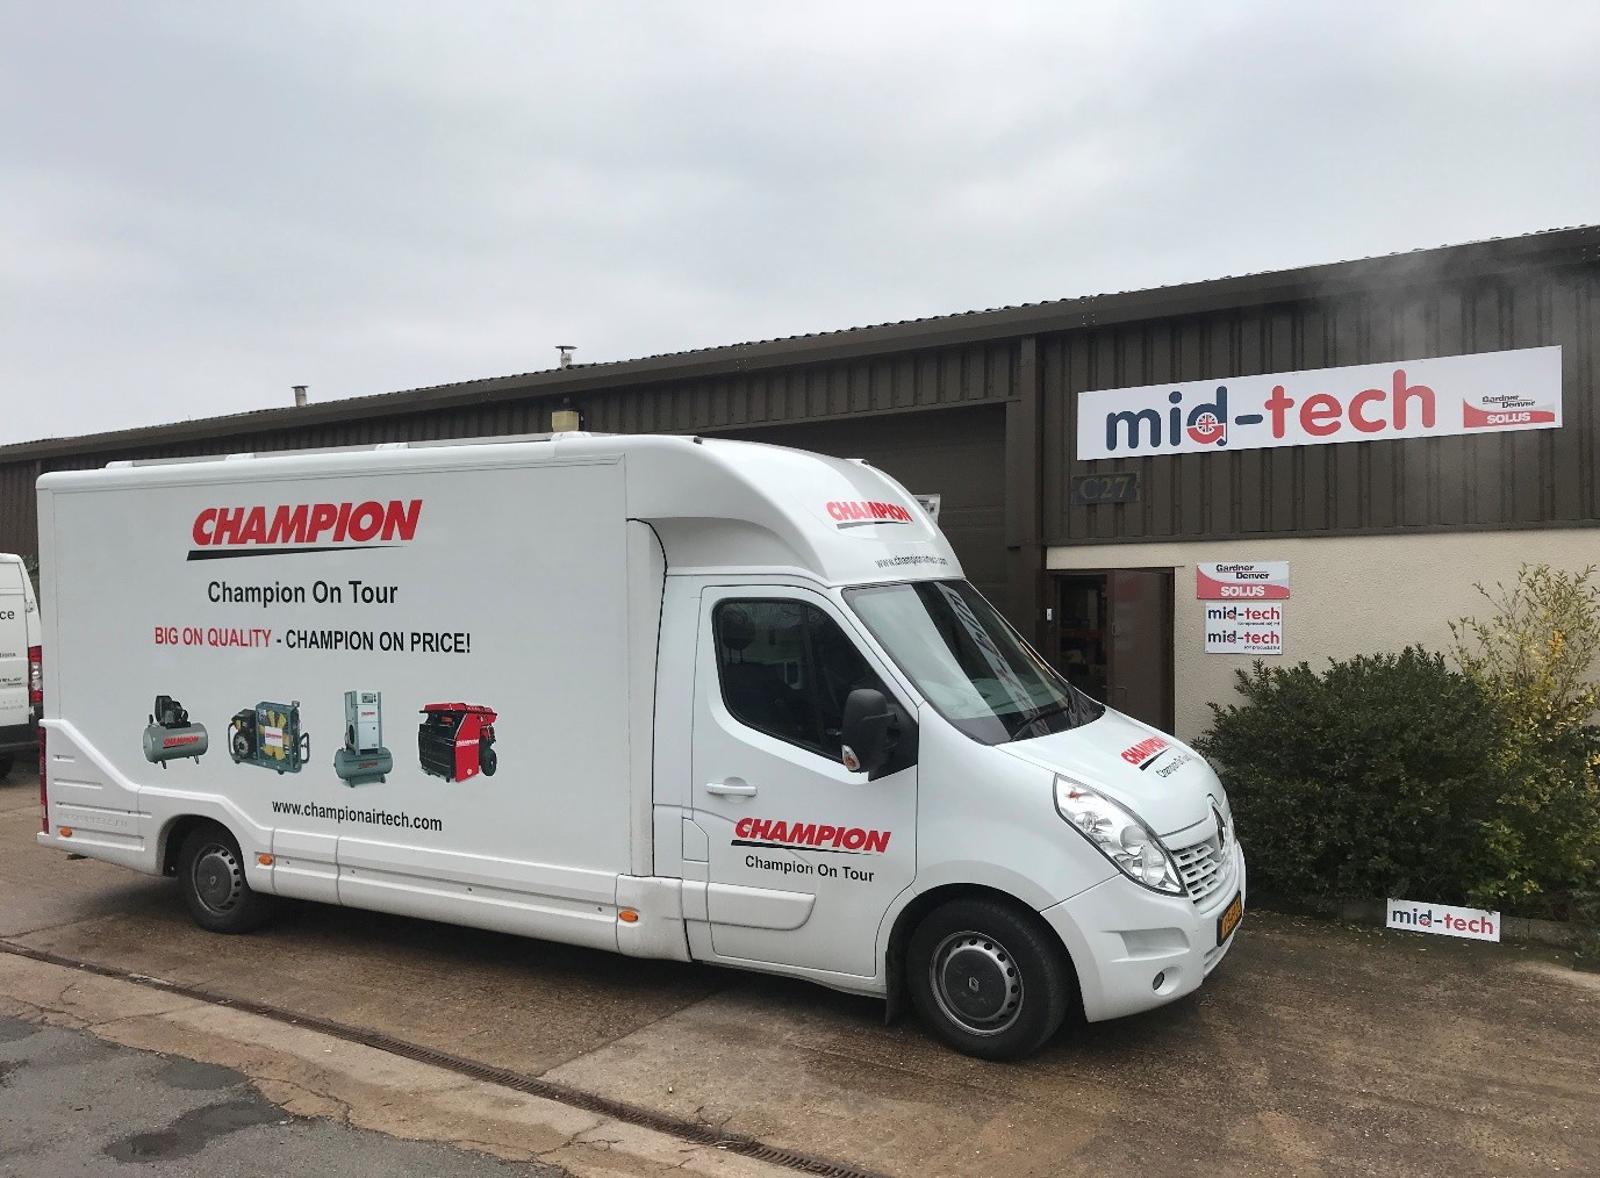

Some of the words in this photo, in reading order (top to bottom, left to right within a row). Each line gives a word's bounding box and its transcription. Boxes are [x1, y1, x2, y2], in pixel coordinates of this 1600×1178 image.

[1105, 368, 1436, 451] mid-tech
[1486, 411, 1531, 424] SOLUS
[1079, 477, 1129, 498] C27
[192, 499, 423, 546] CHAMPION
[825, 501, 913, 522] CHAMPION
[1215, 564, 1254, 573] Gardner
[1236, 572, 1270, 580] Denver
[207, 580, 306, 608] Champion
[312, 580, 342, 604] On
[348, 580, 398, 604] Tour
[1220, 585, 1265, 597] SOLUS
[1207, 605, 1280, 621] mid-tech
[154, 627, 179, 645] BIG
[182, 627, 204, 646] ON
[207, 627, 272, 648] QUALITY
[286, 629, 374, 651] CHAMPION
[379, 631, 404, 651] ON
[410, 632, 471, 653] PRICE!
[1207, 629, 1280, 645] mid-tech
[271, 799, 443, 832] www.championairtech.com
[735, 817, 892, 854] CHAMPION
[745, 855, 813, 875] Champion
[817, 864, 838, 878] On
[842, 866, 875, 882] Tour
[1392, 908, 1494, 935] mid-tech
